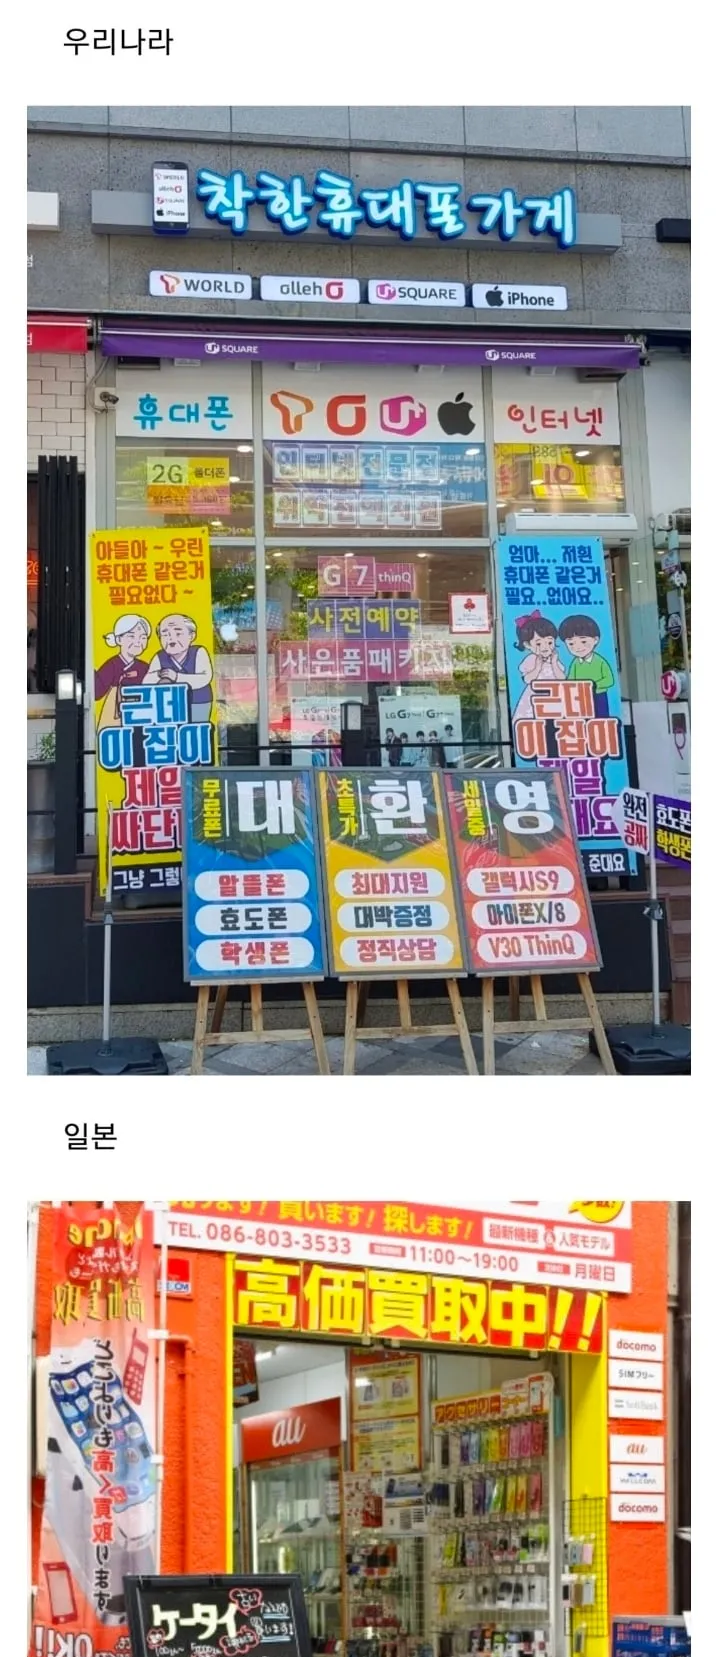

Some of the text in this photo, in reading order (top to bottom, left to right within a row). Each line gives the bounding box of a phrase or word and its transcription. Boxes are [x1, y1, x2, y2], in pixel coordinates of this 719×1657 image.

[184, 278, 245, 295] WORLD
[280, 281, 322, 297] olleh
[398, 286, 457, 301] SQUARE
[507, 291, 555, 307] iPhone
[133, 393, 233, 431] 휴대폰
[507, 404, 604, 437] 인터넷
[96, 538, 204, 560] 아들아 우린
[97, 561, 205, 583] 휴대폰 같은거
[108, 585, 177, 606] 필요없다
[310, 606, 421, 634] 사전예약
[121, 684, 188, 726] 근데
[531, 680, 594, 719] 근데
[203, 778, 222, 838] 무료폰
[237, 780, 296, 835] 대
[336, 779, 358, 836] 초특가
[368, 779, 428, 835] 환
[494, 779, 555, 835] 영
[219, 873, 286, 897] 알뜰폰
[351, 871, 429, 895] 최대지원
[481, 870, 559, 892] 갤럭시S9
[220, 907, 288, 932] 효도폰
[354, 905, 433, 928] 대박증정
[487, 902, 566, 926] 아이폰X/8
[220, 942, 289, 966] 학생폰
[357, 939, 437, 962] 정직상담
[488, 934, 575, 958] V30 ThinQ
[168, 1220, 352, 1255] TEL. 086-803-3533
[574, 1262, 617, 1283] 月曜日
[616, 1338, 657, 1352] docomo
[271, 1416, 309, 1448] au
[152, 1603, 238, 1640] ケータイ
